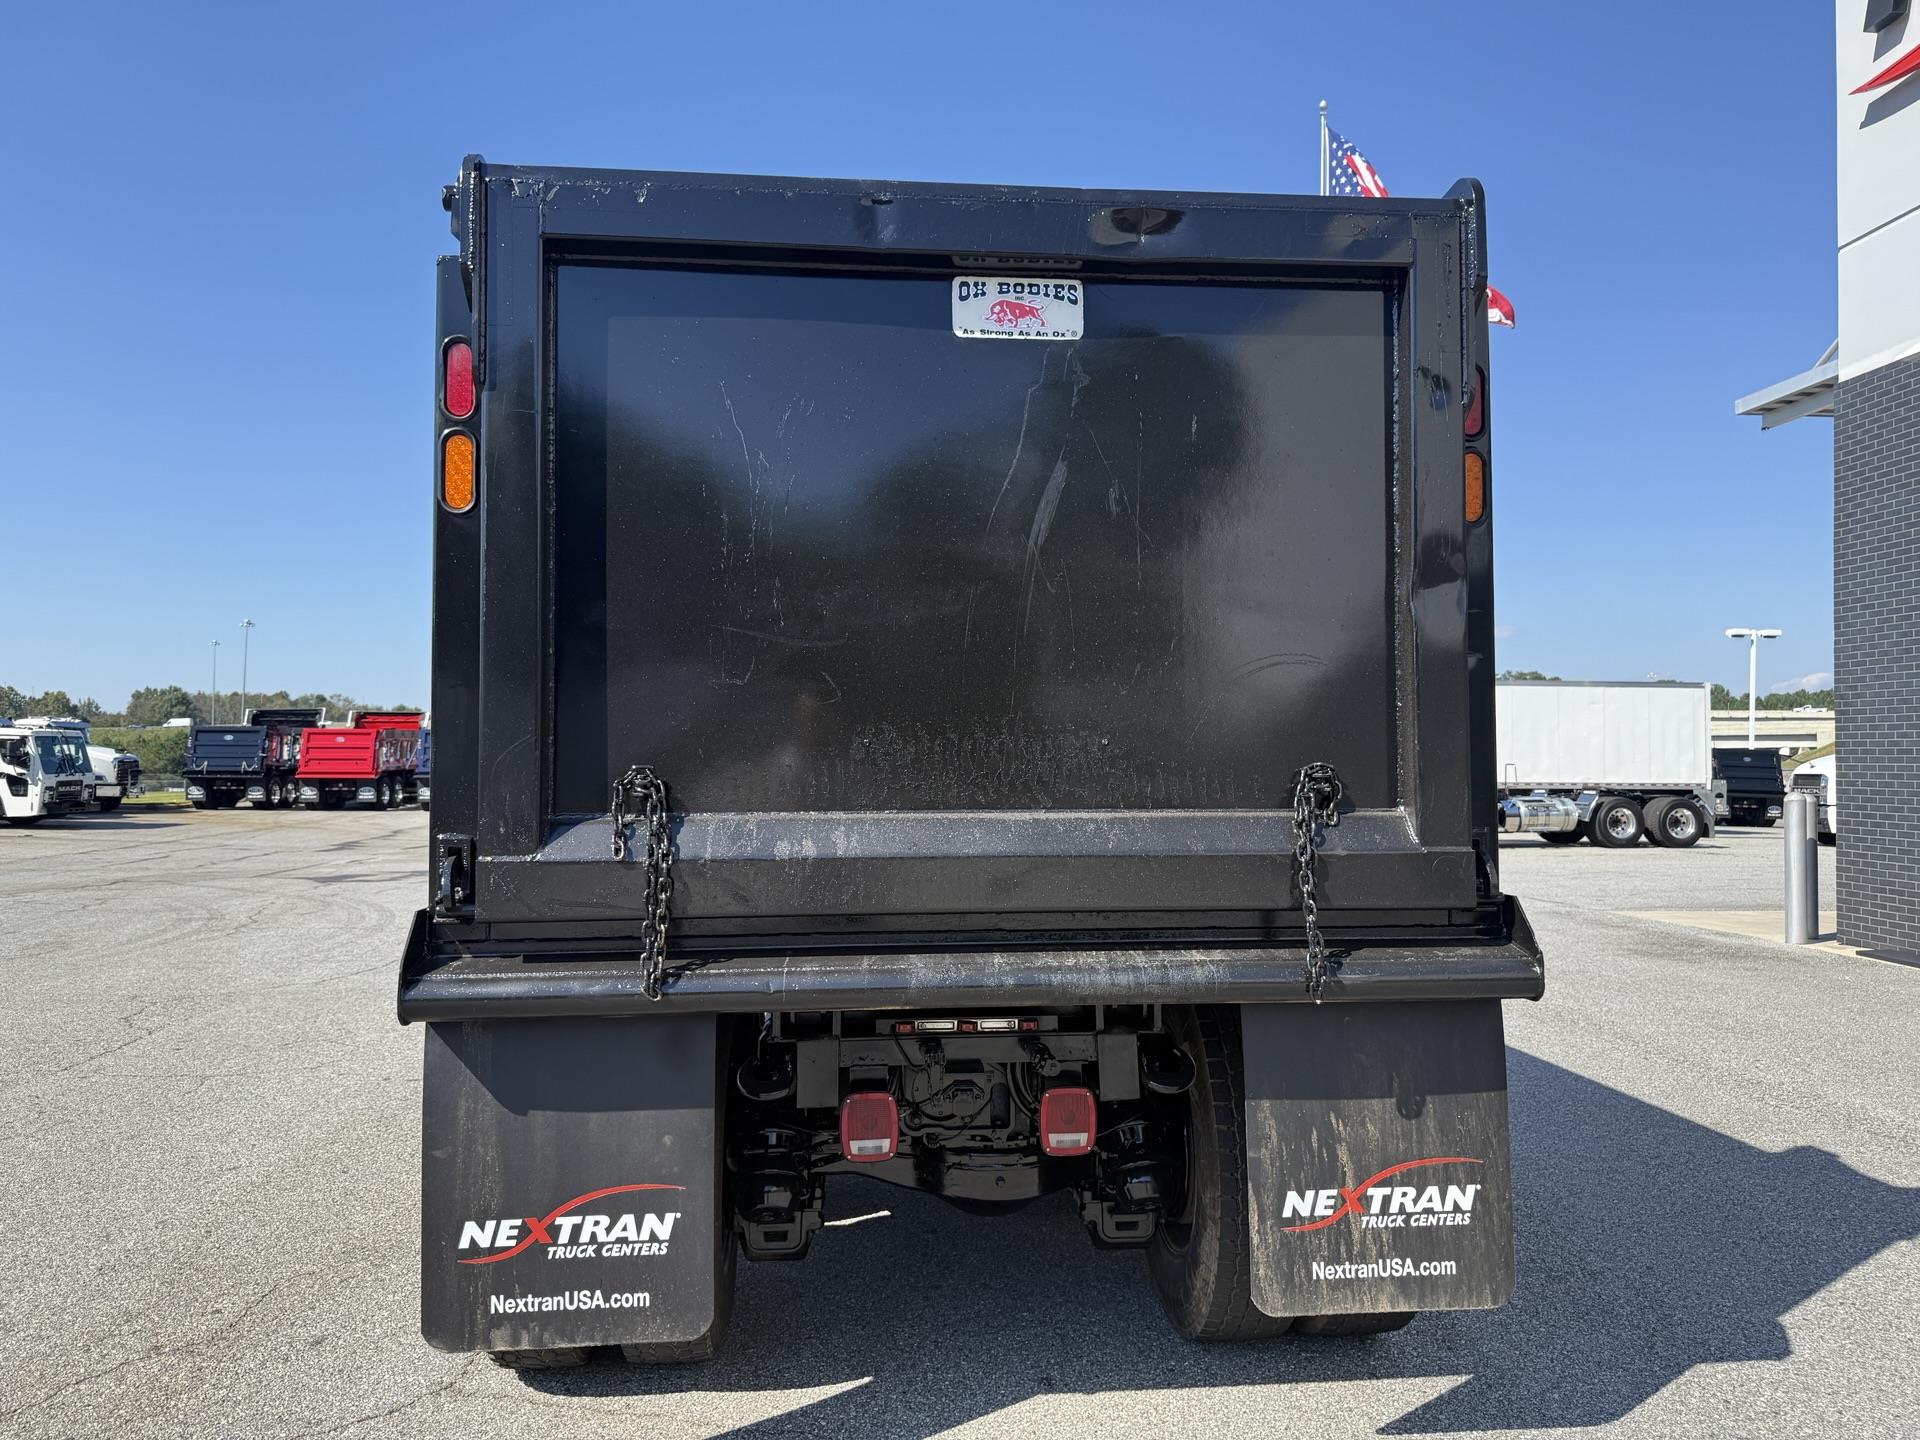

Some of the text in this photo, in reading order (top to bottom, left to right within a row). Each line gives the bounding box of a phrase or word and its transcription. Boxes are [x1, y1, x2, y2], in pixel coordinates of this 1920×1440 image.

[958, 281, 1079, 306] OX BODIES
[980, 328, 1014, 337] Strong
[1281, 1184, 1478, 1219] NEXTRAN
[457, 1212, 678, 1250] NEXTRAN
[1360, 1212, 1471, 1229] TRUCK CENTERS
[547, 1242, 669, 1260] TRUCK CENTERS
[1311, 1258, 1457, 1281] NextranUSA.com
[490, 1289, 650, 1315] NextranUSA.com
